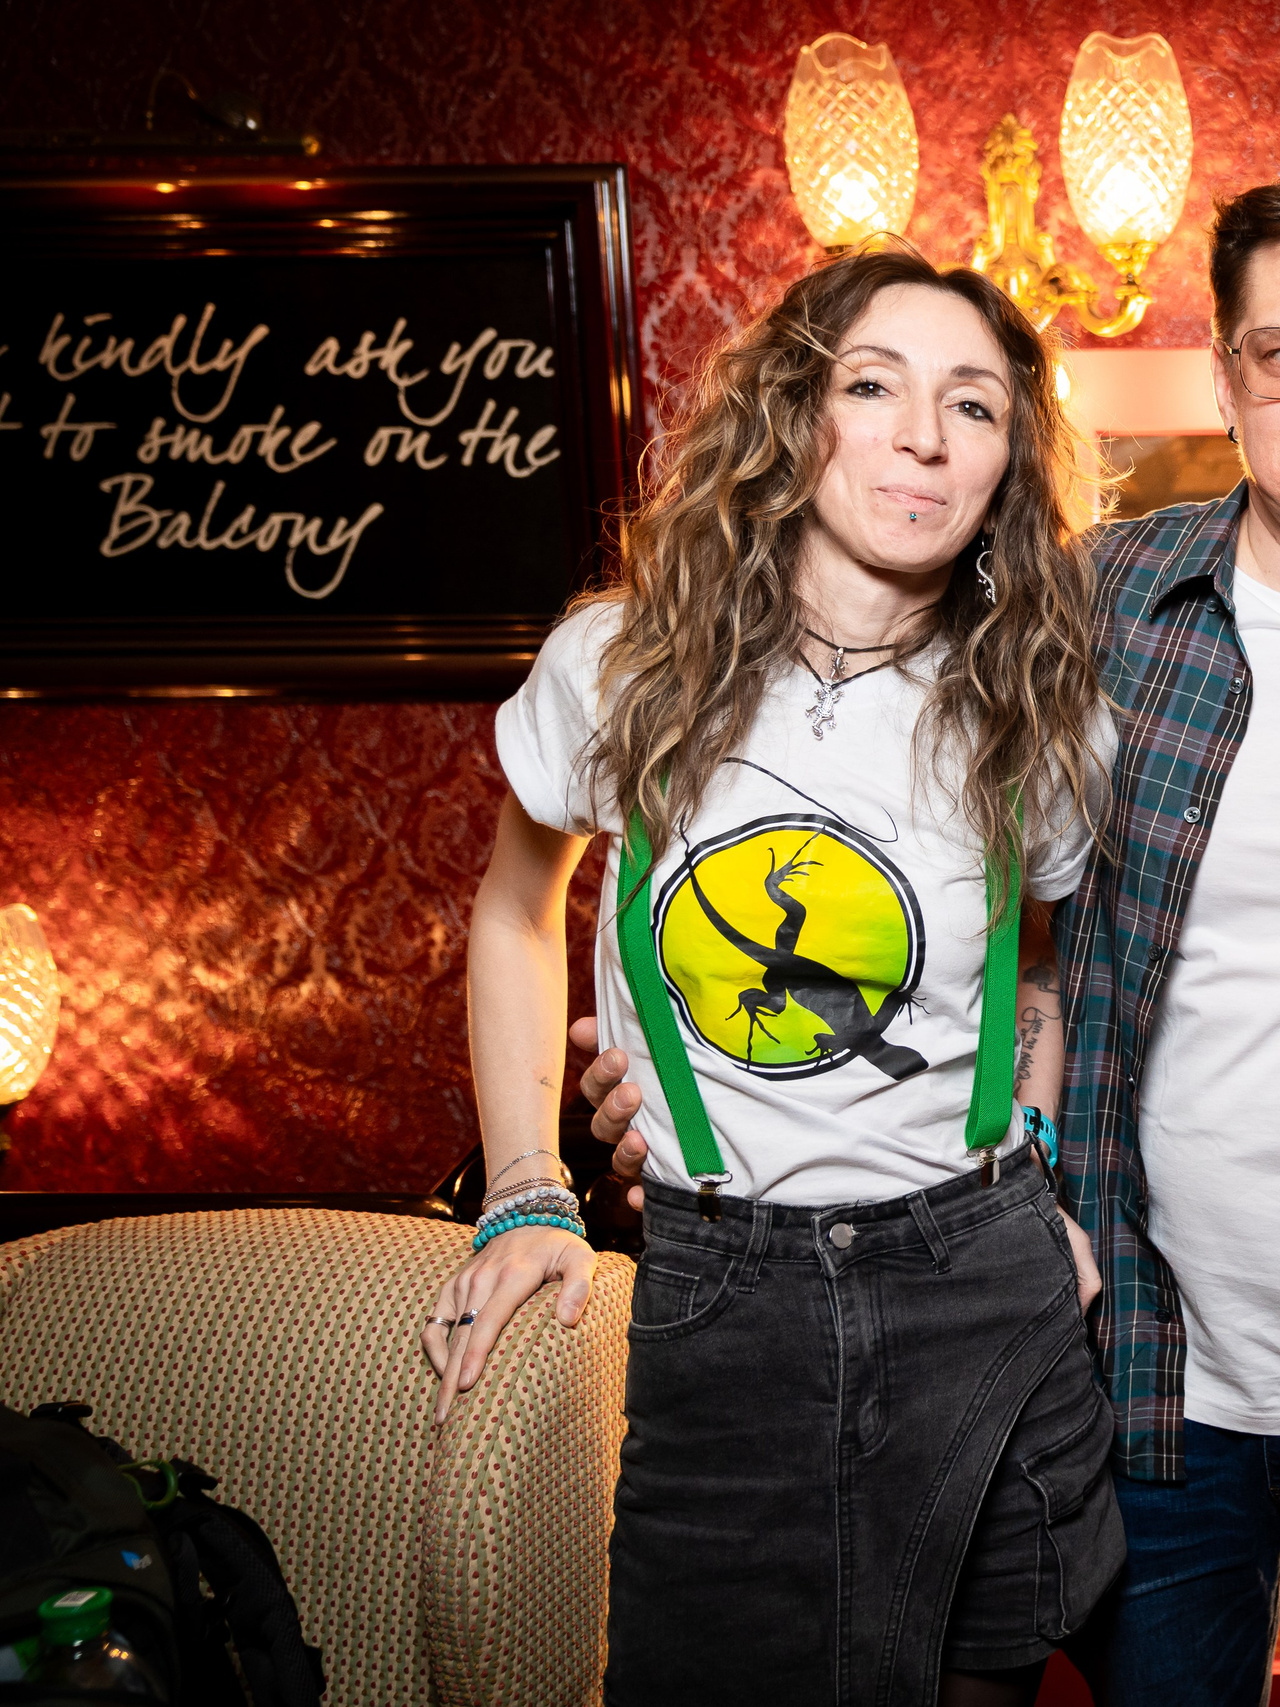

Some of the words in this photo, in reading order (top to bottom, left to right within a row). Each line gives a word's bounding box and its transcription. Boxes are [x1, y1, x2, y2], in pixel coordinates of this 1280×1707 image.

[38, 301, 270, 424] kindly
[304, 316, 430, 386] ask
[397, 326, 555, 428] you
[40, 391, 118, 462] to
[136, 403, 338, 474] smoke
[363, 425, 449, 471] on
[458, 397, 562, 479] the
[98, 471, 385, 601] Balcony
